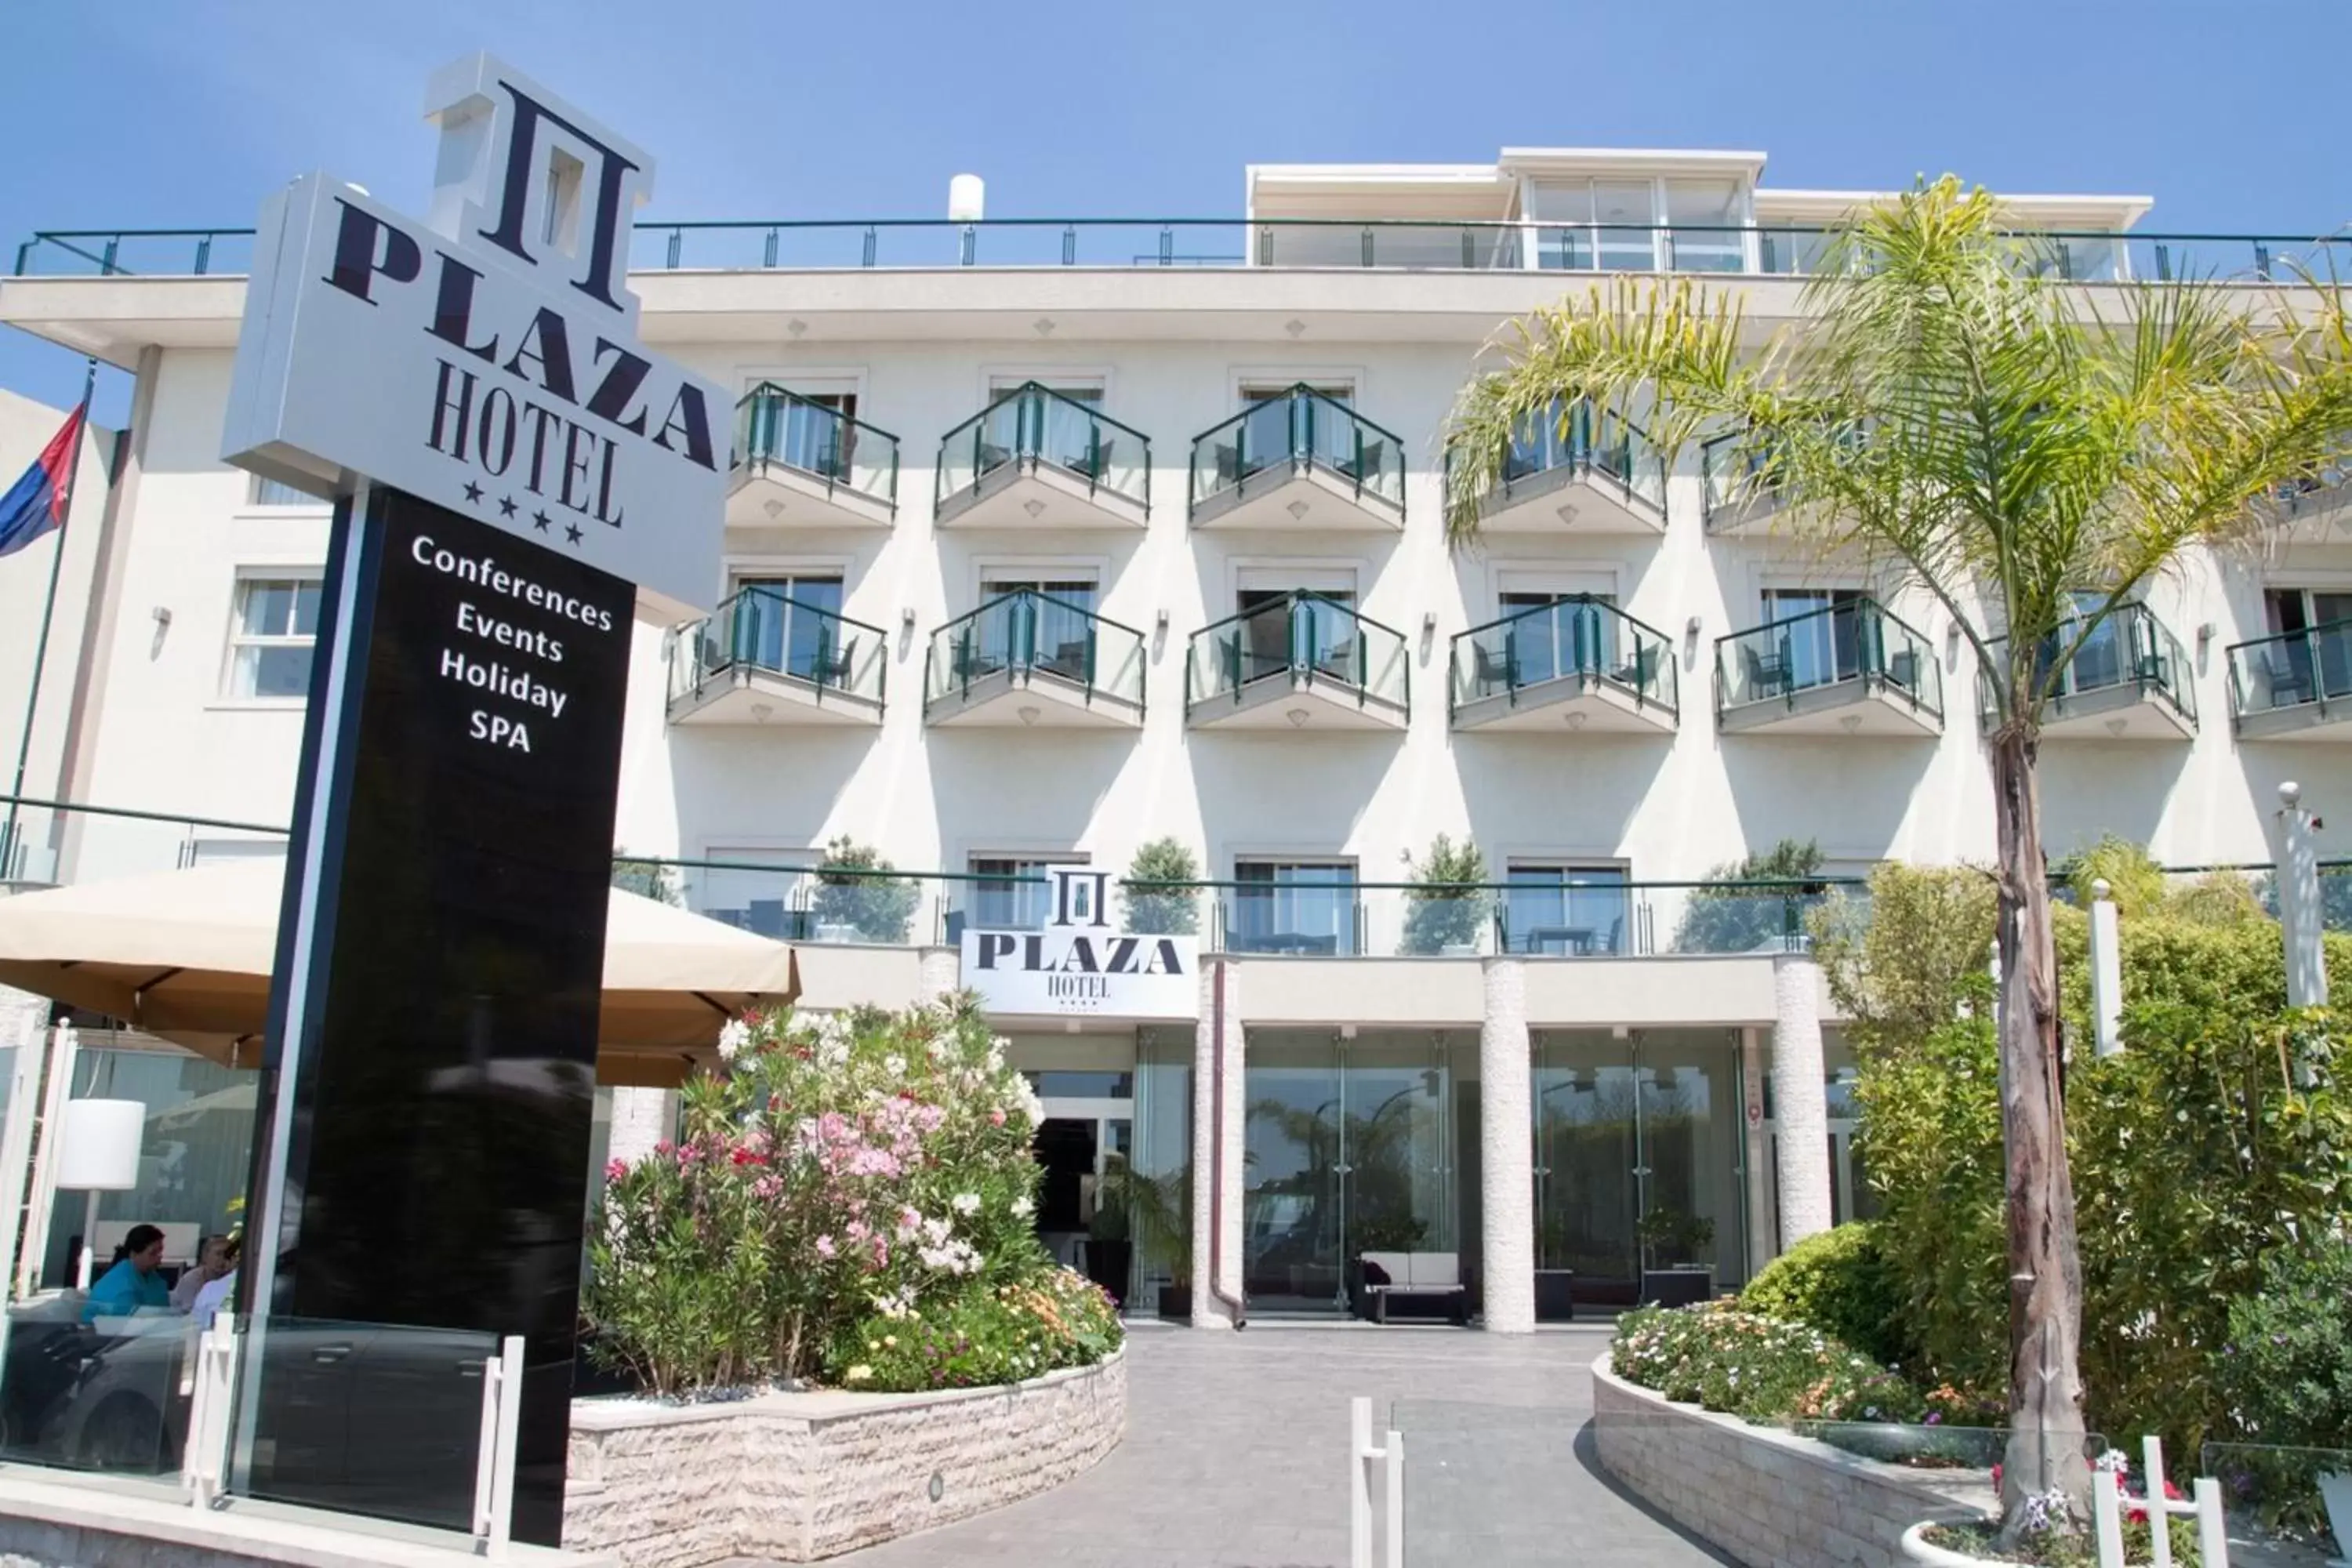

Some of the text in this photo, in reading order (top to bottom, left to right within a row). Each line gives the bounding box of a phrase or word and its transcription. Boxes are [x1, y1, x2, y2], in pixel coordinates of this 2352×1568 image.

[321, 196, 718, 472] PLAZA
[425, 357, 624, 528] HOTEL
[412, 535, 613, 631] Conferences
[456, 601, 563, 662] Events
[441, 648, 567, 718] Holiday
[470, 710, 531, 753] SPA
[974, 934, 1183, 975] PLAZA
[1047, 976, 1111, 998] HOTEL
